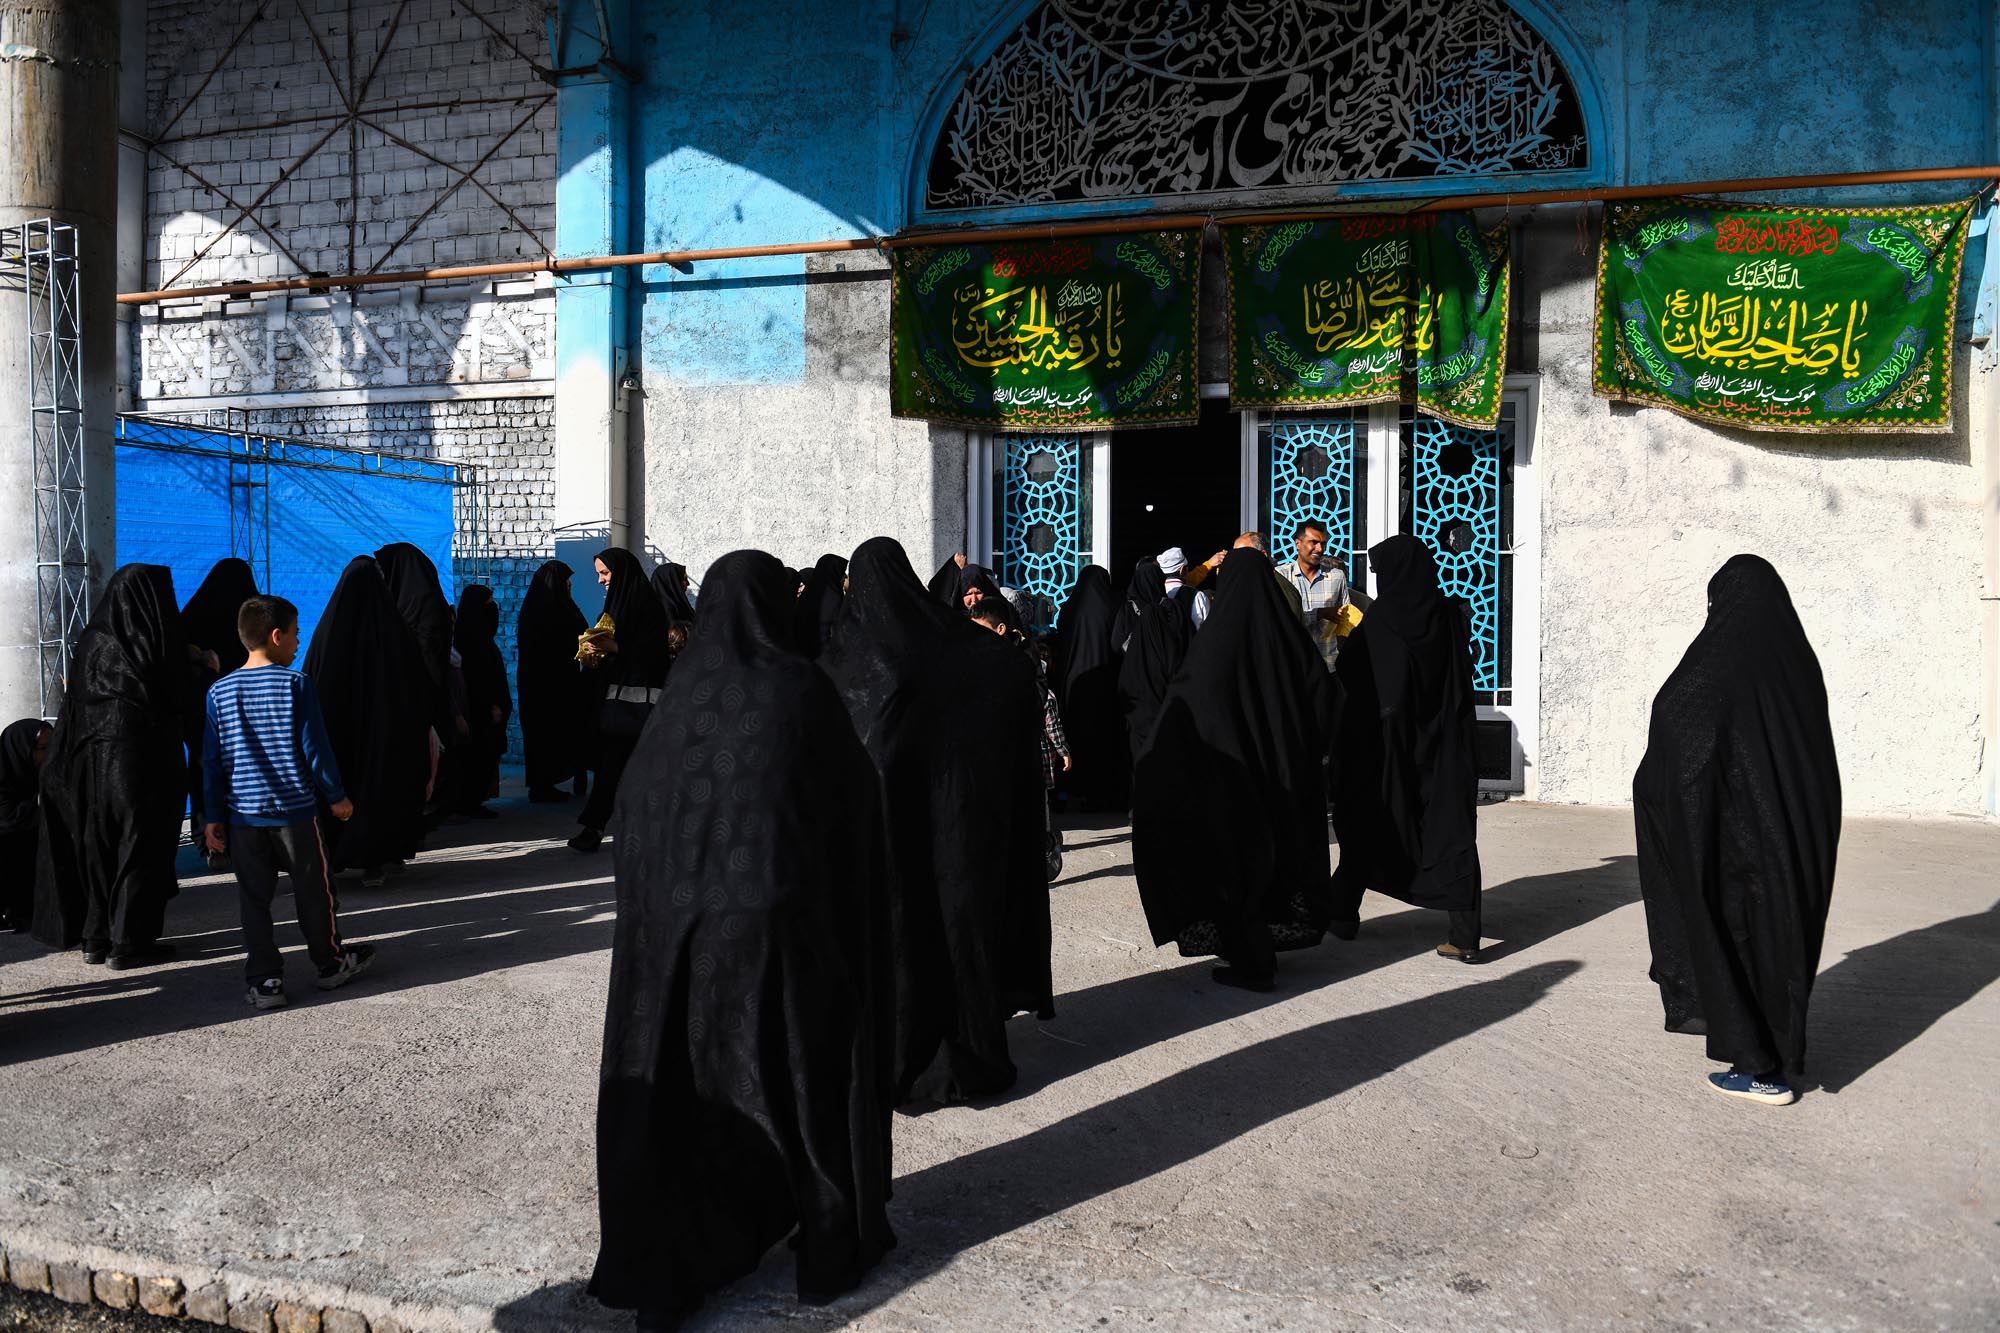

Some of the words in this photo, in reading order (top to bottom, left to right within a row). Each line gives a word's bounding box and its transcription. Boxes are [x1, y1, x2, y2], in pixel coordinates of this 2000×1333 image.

[1771, 383, 1816, 405] موکب
[1696, 395, 1760, 413] سیرجان
[1760, 401, 1811, 417] شهرستان
